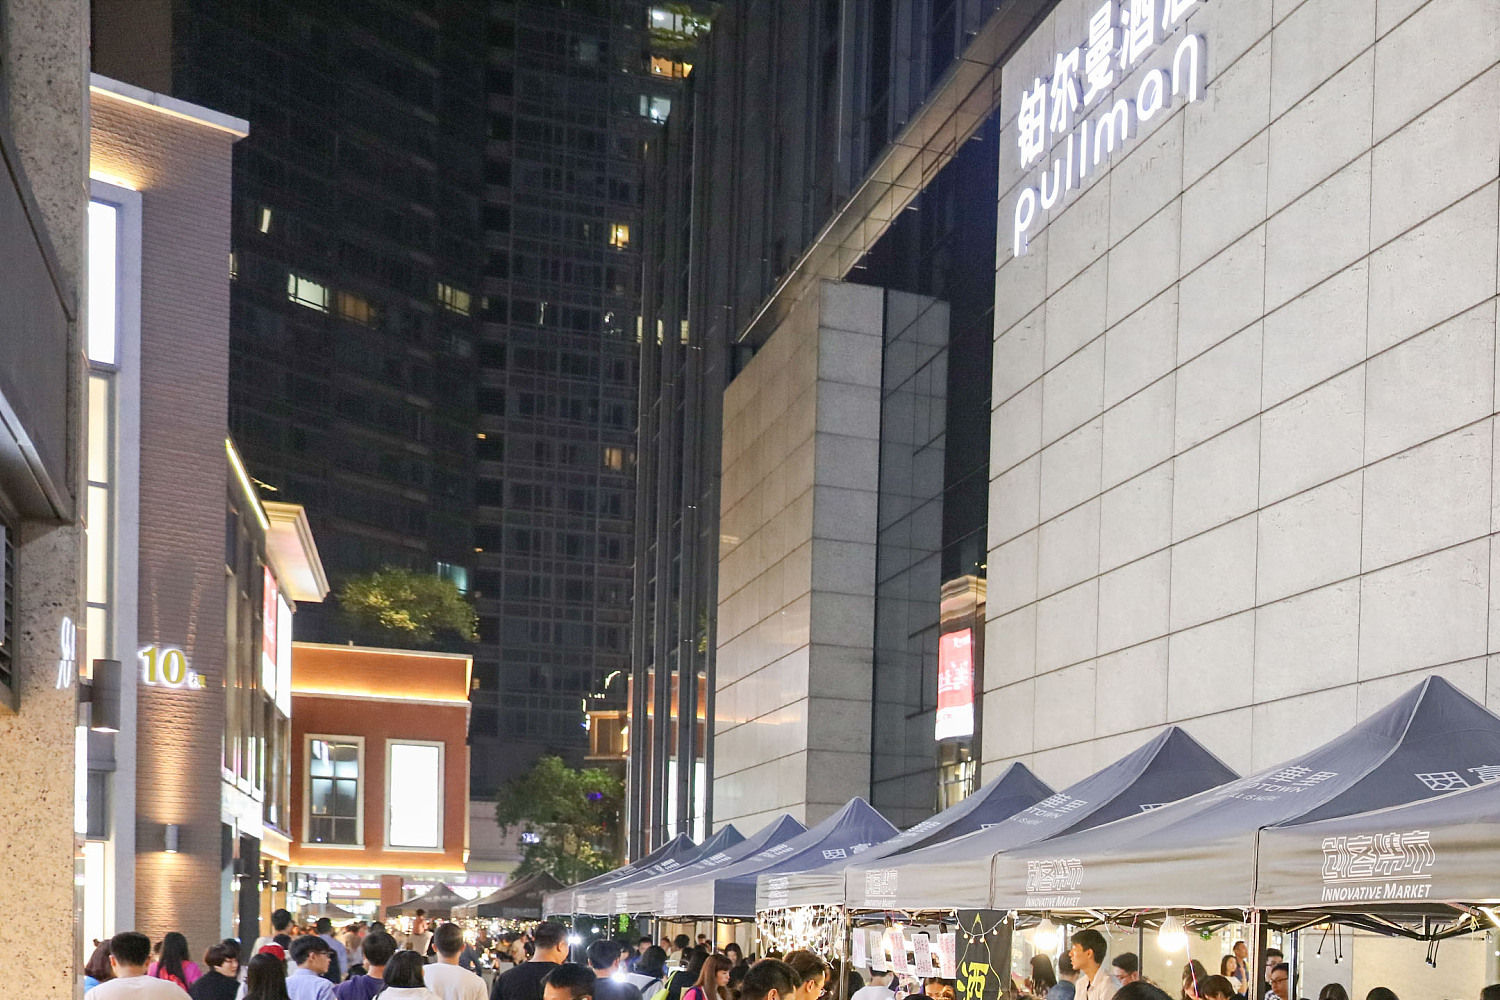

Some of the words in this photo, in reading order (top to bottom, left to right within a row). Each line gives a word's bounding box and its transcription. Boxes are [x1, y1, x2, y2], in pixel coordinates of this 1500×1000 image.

[1014, 34, 1198, 257] pullman
[139, 646, 187, 686] 10
[1321, 886, 1382, 902] INNOVATIVE
[1383, 882, 1432, 900] MARKET
